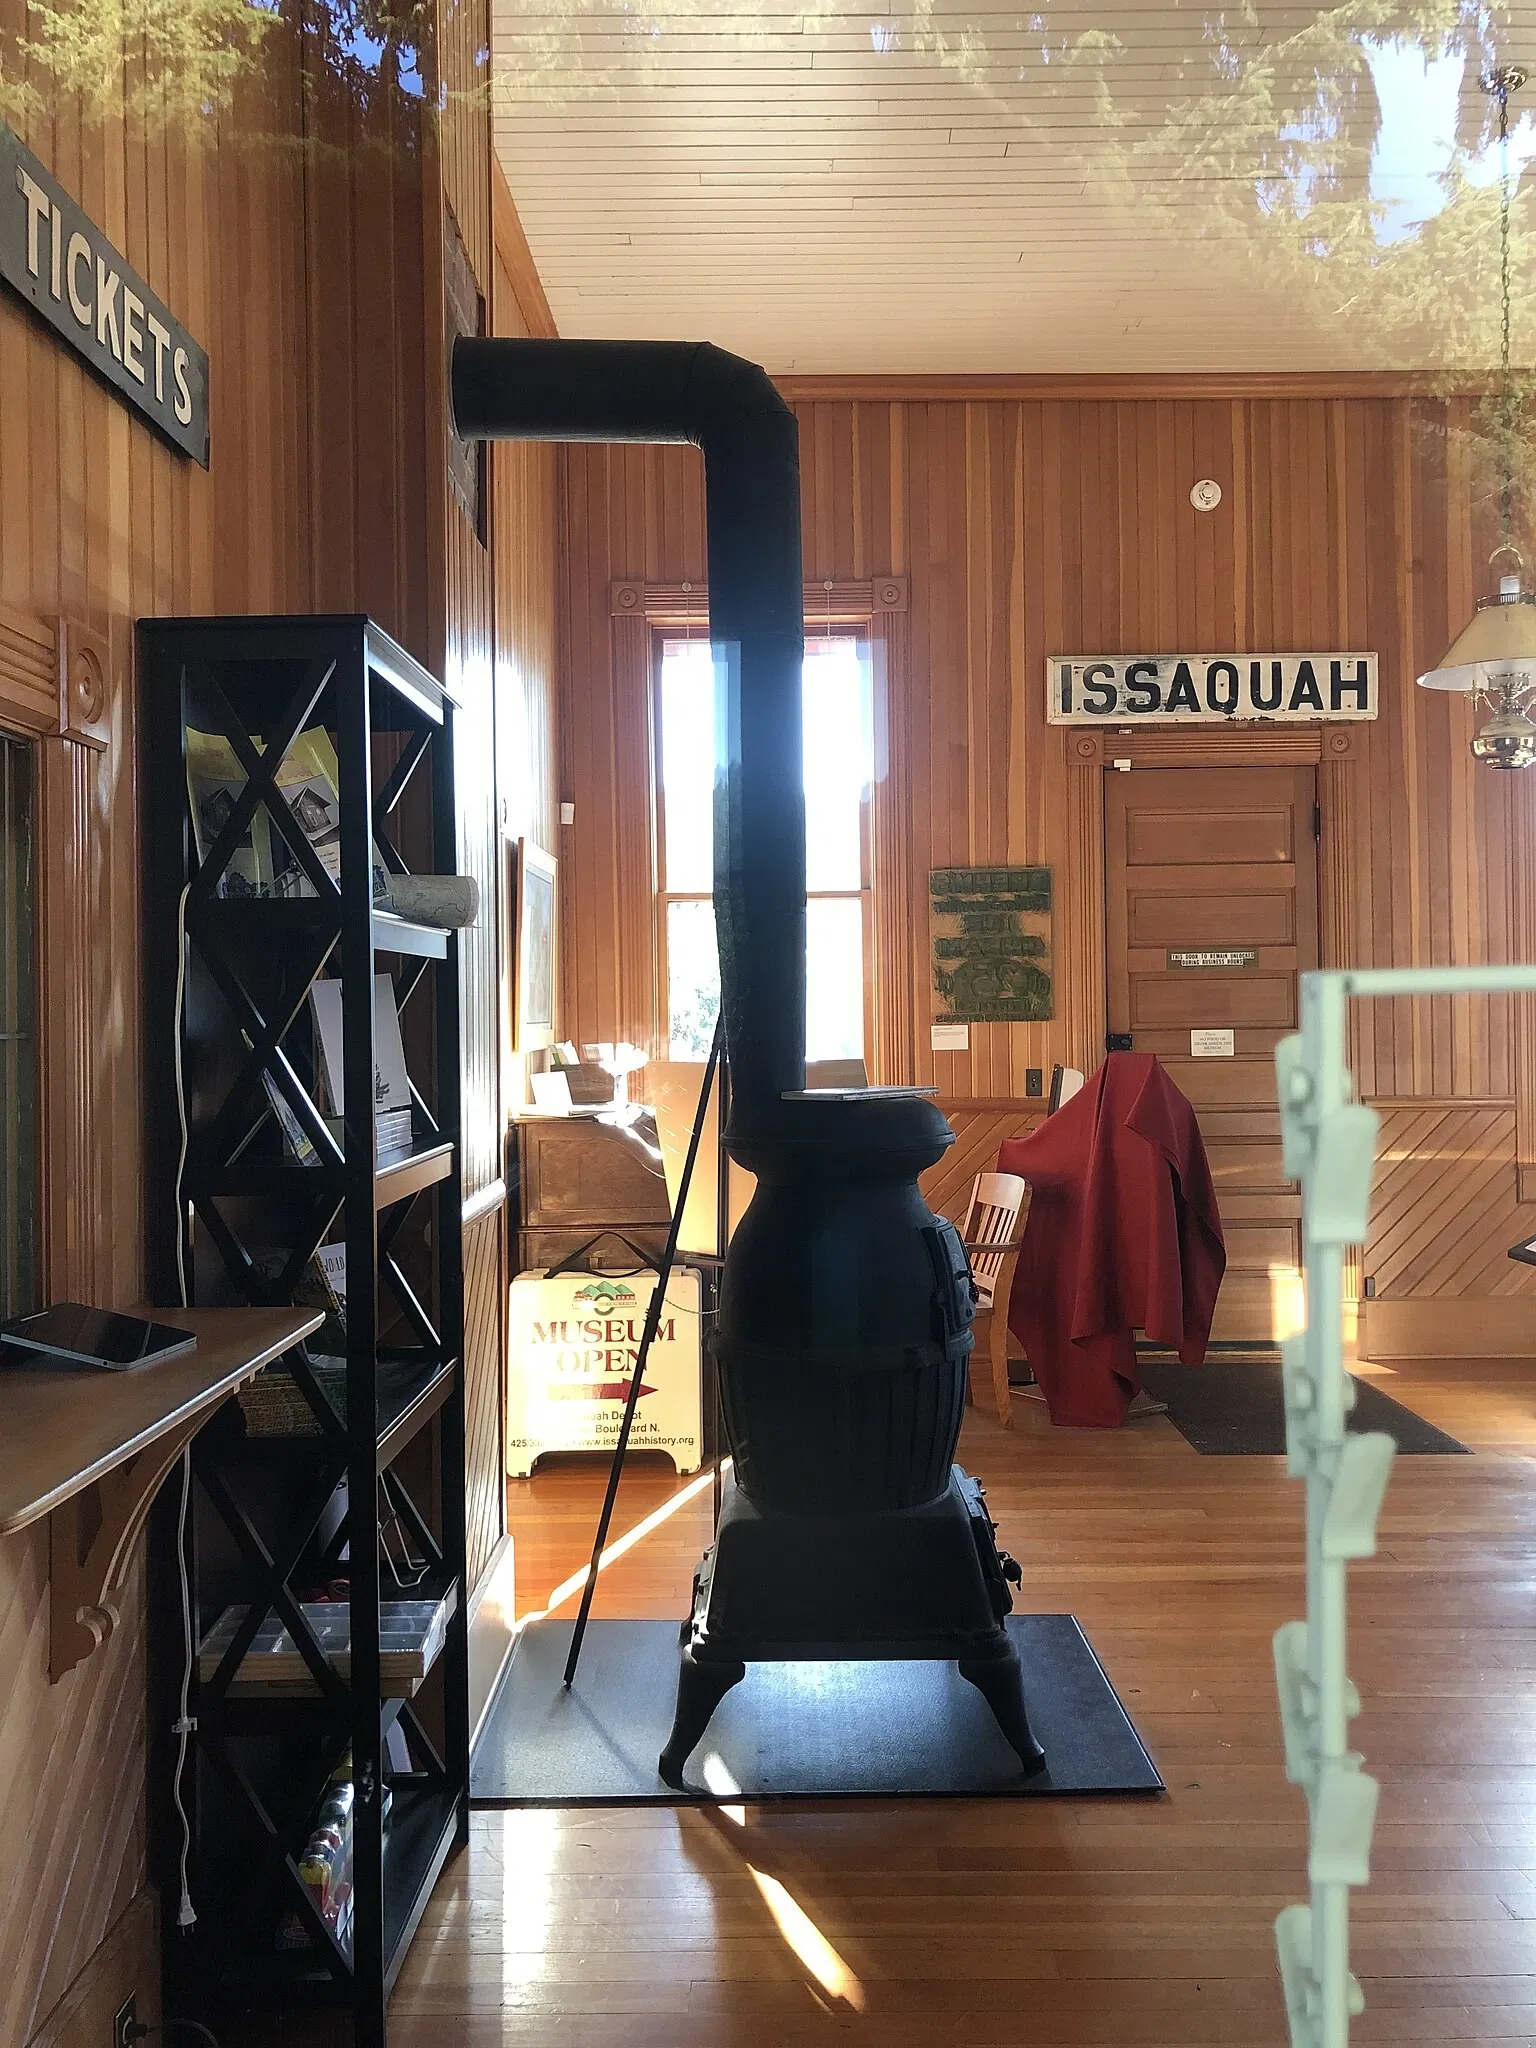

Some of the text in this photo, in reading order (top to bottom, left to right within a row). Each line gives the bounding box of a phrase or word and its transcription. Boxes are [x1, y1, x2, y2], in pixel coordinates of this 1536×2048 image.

[15, 164, 193, 426] TICKETS
[1060, 660, 1369, 715] ISSAQUAH
[531, 1318, 676, 1344] MUSEUM
[556, 1349, 648, 1373] OPEN
[611, 1411, 642, 1420] Deot
[649, 1422, 660, 1432] N.
